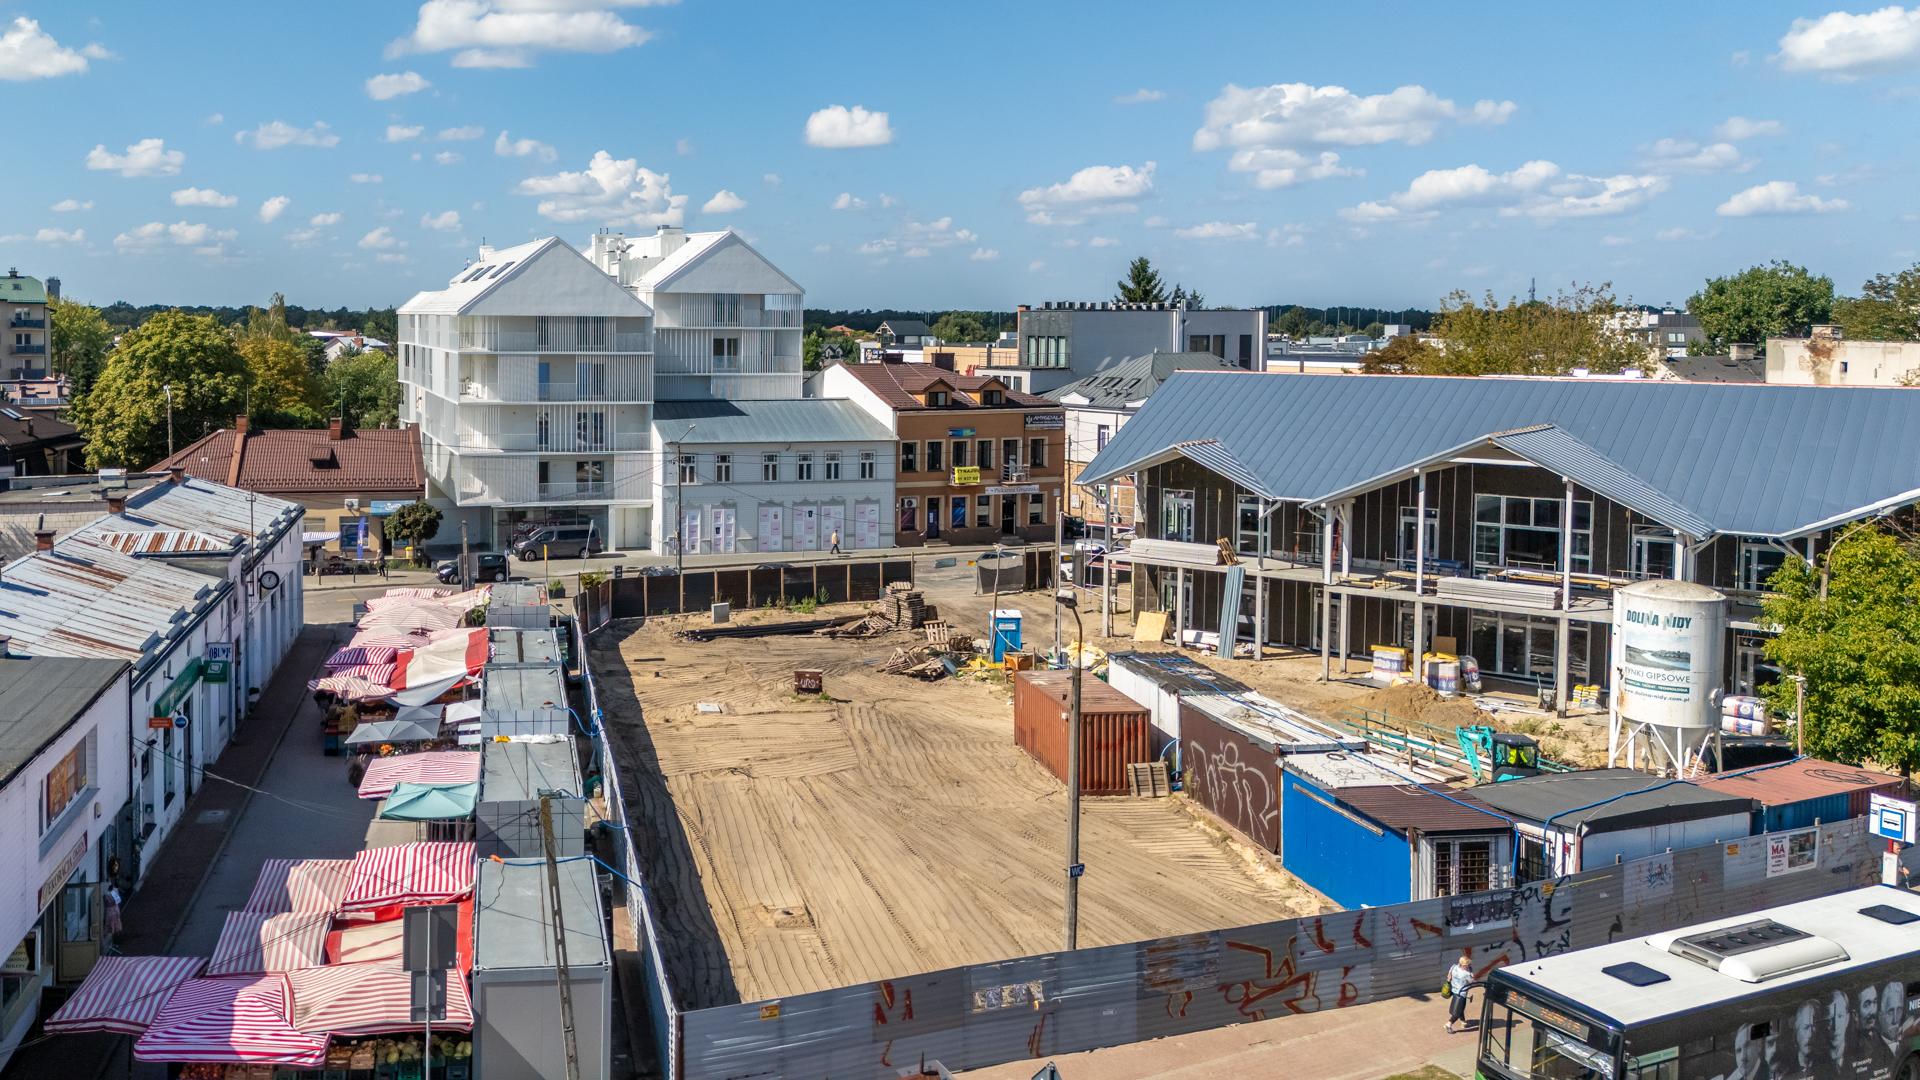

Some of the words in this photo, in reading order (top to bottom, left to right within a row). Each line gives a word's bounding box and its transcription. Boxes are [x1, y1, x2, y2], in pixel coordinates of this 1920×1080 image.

[1626, 609, 1659, 627] DOLINA
[1663, 612, 1692, 630] NIDY
[1646, 671, 1691, 684] GIPSOWE
[1771, 844, 1785, 856] MA
[1071, 865, 1084, 876] WC
